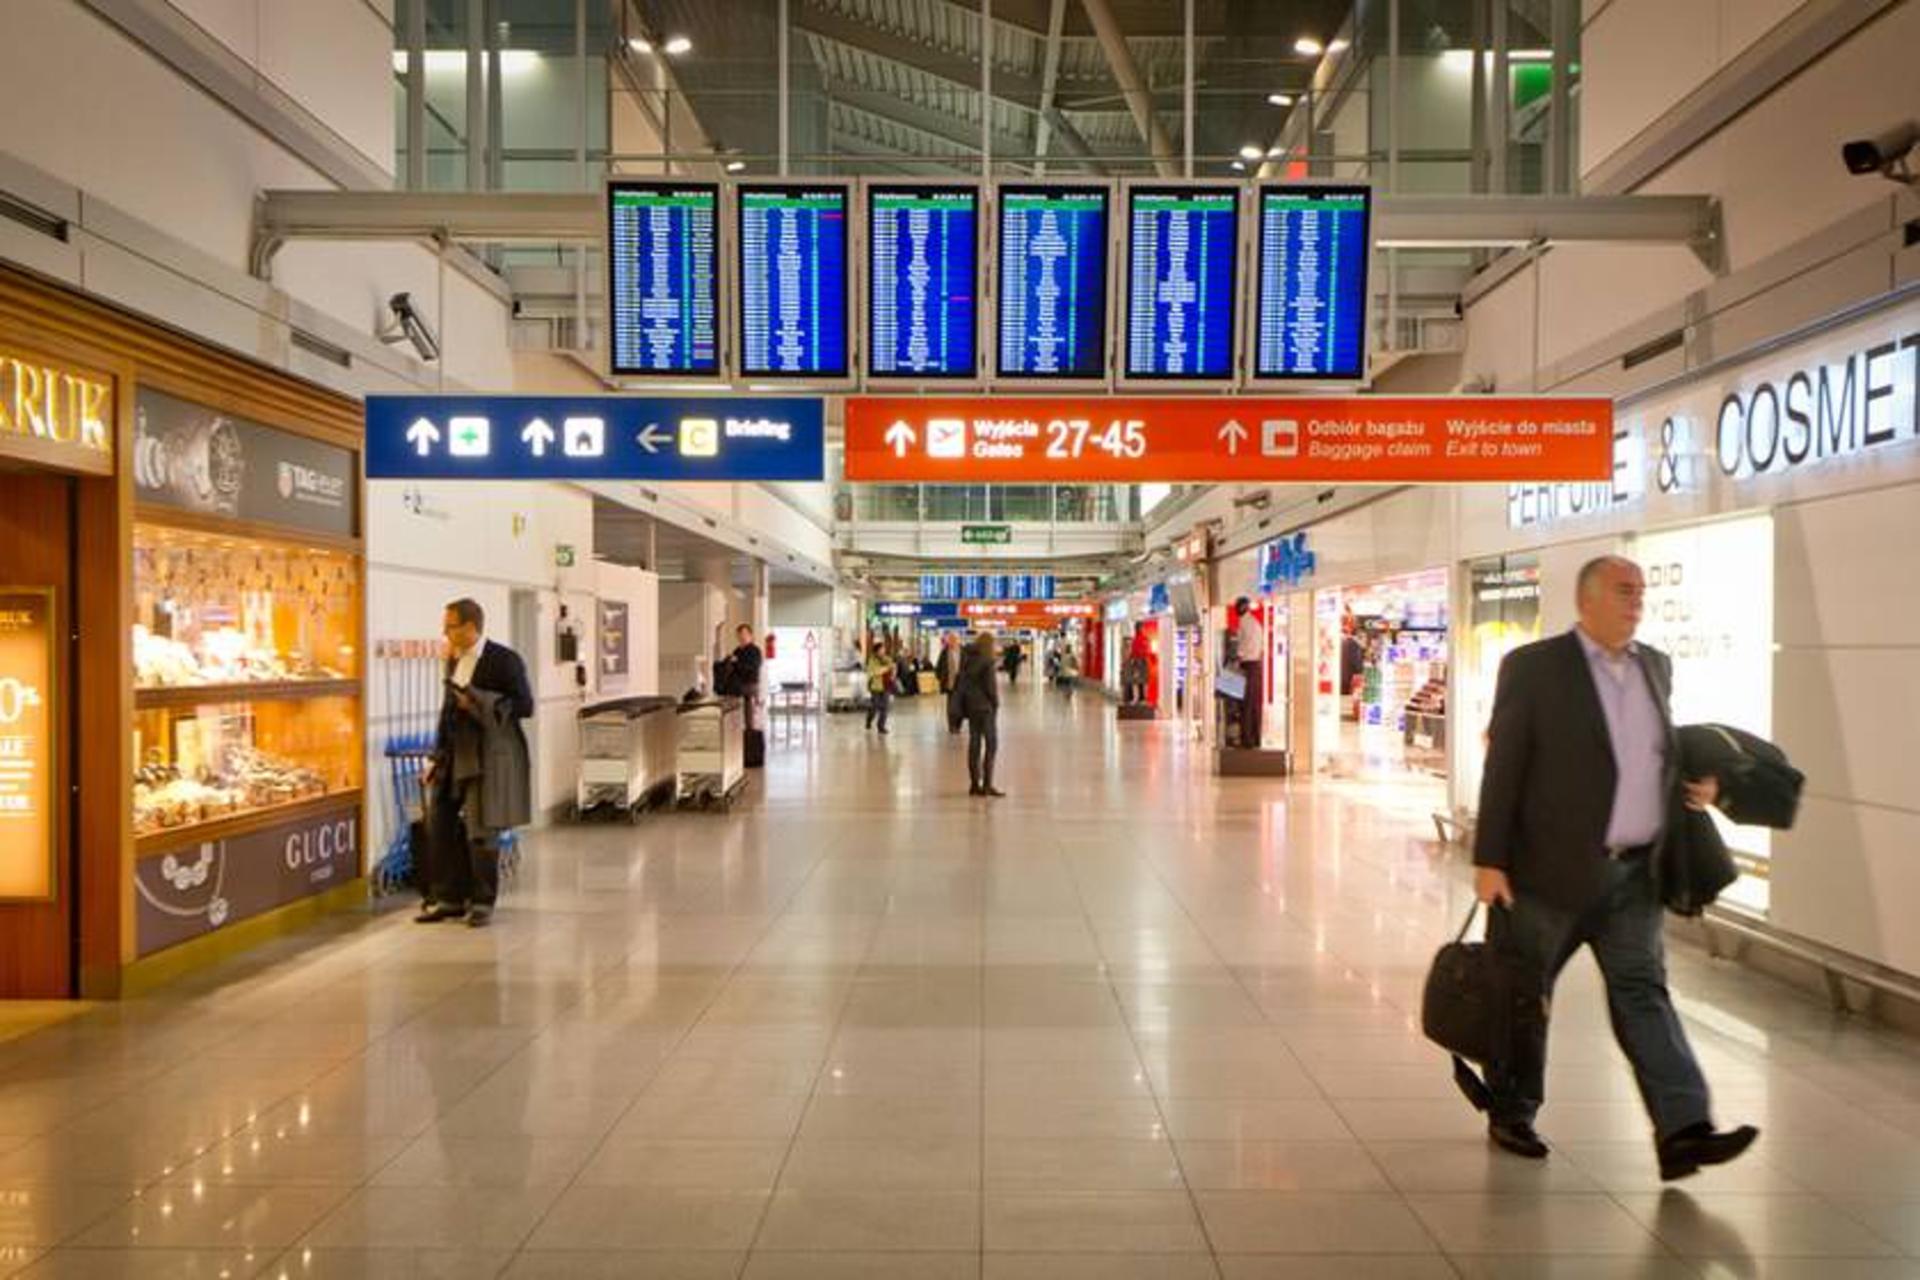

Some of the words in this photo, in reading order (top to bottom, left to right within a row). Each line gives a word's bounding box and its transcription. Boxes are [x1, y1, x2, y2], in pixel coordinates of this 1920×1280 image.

[1657, 417, 1680, 494] &
[1716, 333, 1920, 476] COSMET
[726, 418, 792, 440] Briefing
[1308, 419, 1362, 436] Odbiór
[1517, 419, 1537, 435] do
[1542, 419, 1597, 435] miasta
[1046, 419, 1146, 458] 27-45
[1446, 439, 1479, 457] Exit
[1481, 441, 1498, 456] to
[1501, 441, 1543, 456] town
[1309, 440, 1383, 461] Baggage
[1387, 441, 1431, 456] claim
[1648, 562, 1683, 588] DID
[285, 818, 356, 869] GUCCI
